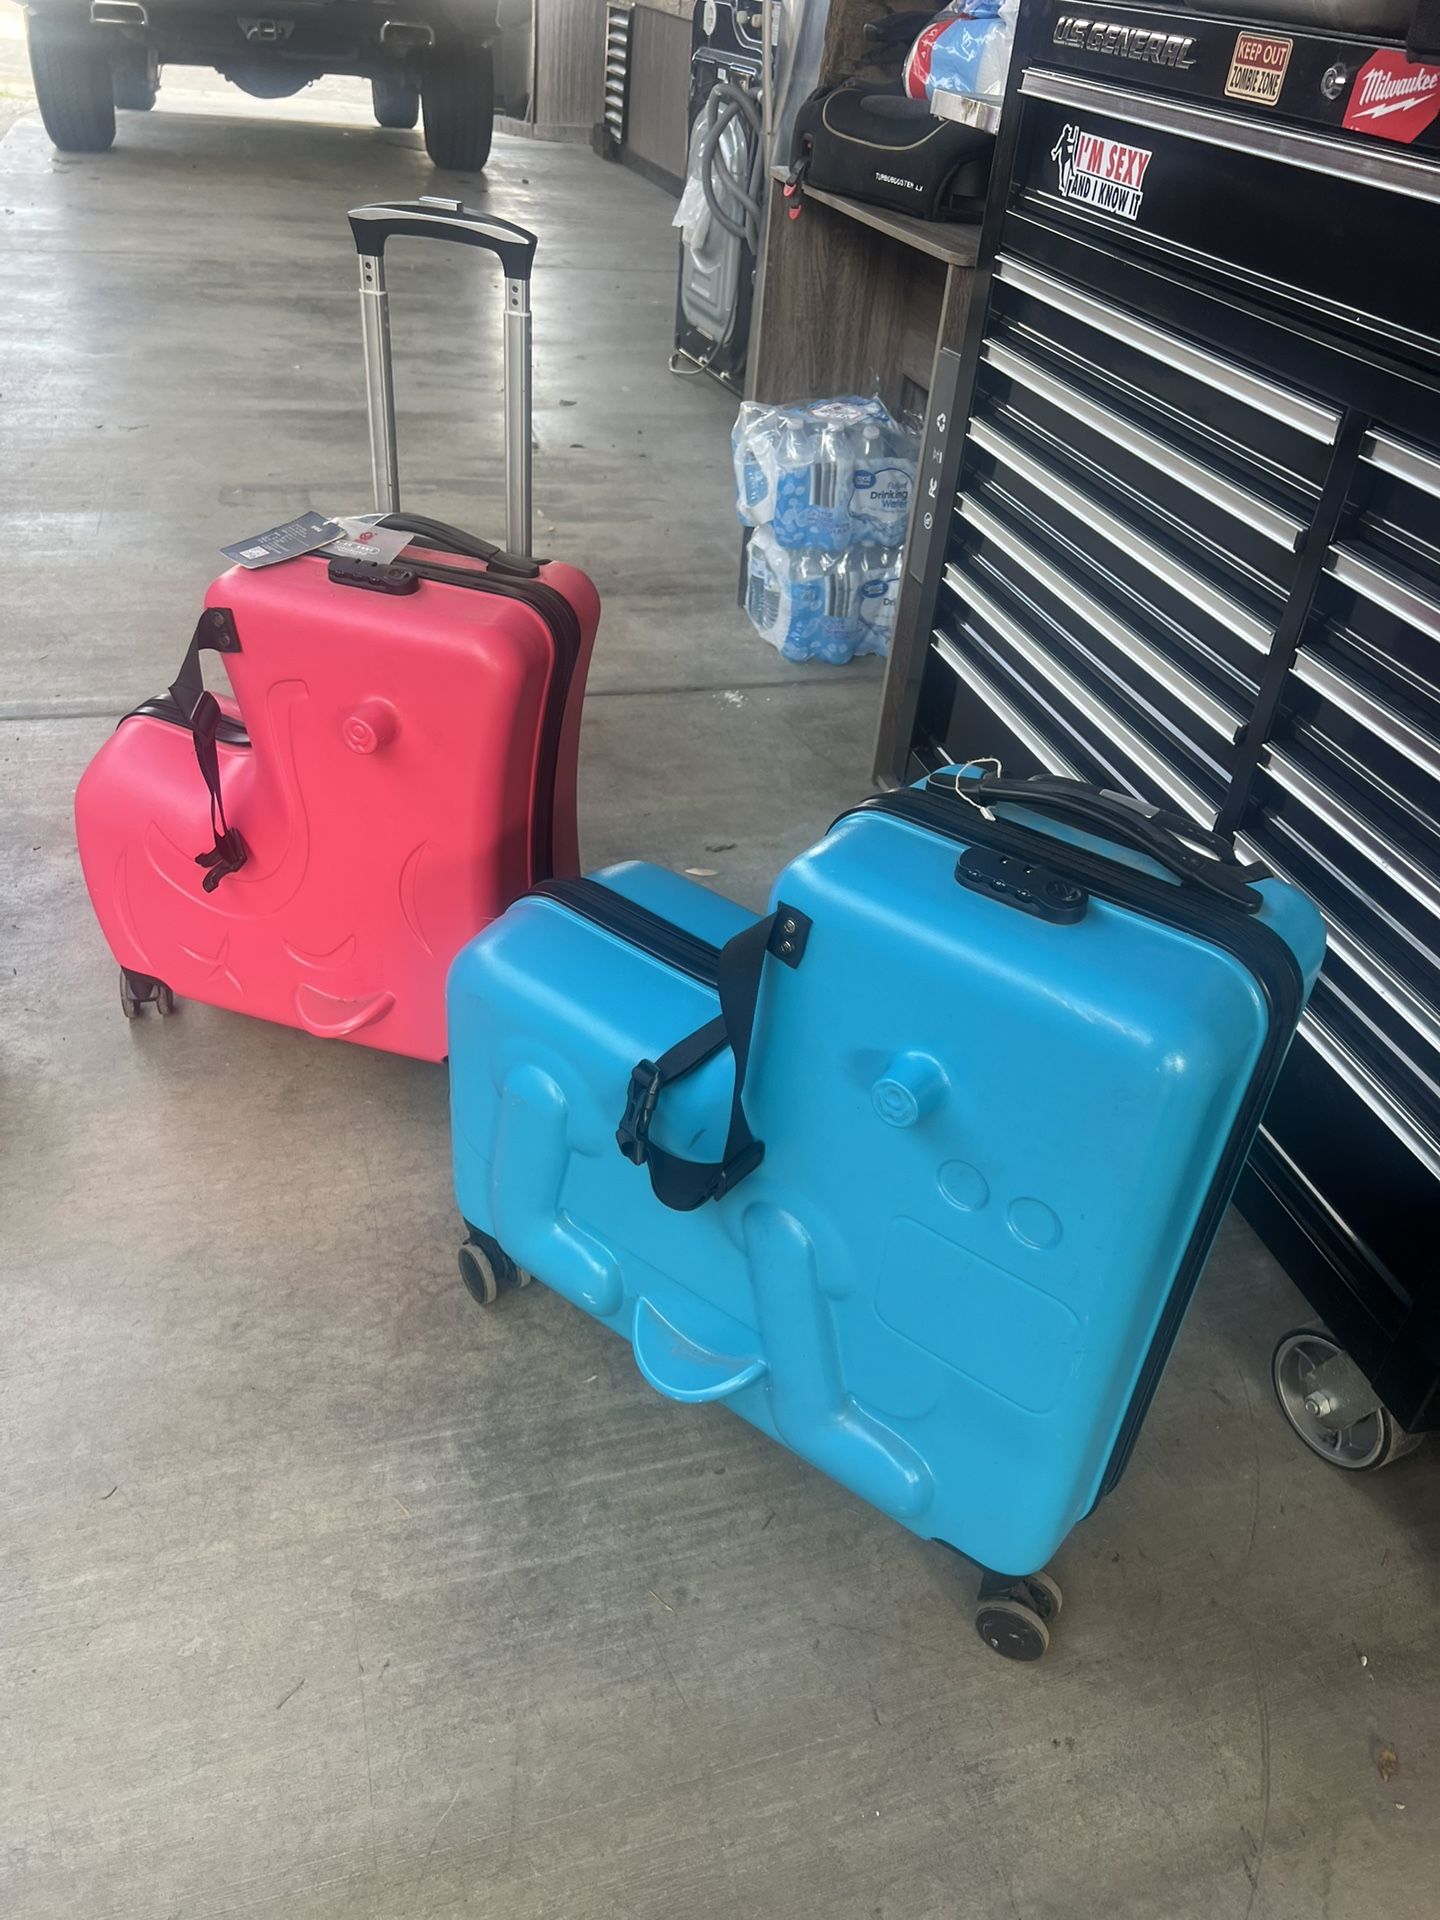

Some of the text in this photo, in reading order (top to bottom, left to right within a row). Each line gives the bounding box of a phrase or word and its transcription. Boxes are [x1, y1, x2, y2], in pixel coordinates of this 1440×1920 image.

[1086, 22, 1197, 69] GENERAL
[1238, 41, 1287, 65] KEEP OUT
[1230, 66, 1281, 96] ZOMBIE ZONE
[1359, 67, 1438, 106] Milwaukee
[1076, 135, 1149, 187] I'M SEXY
[1071, 174, 1141, 217] AND I KNOW IT
